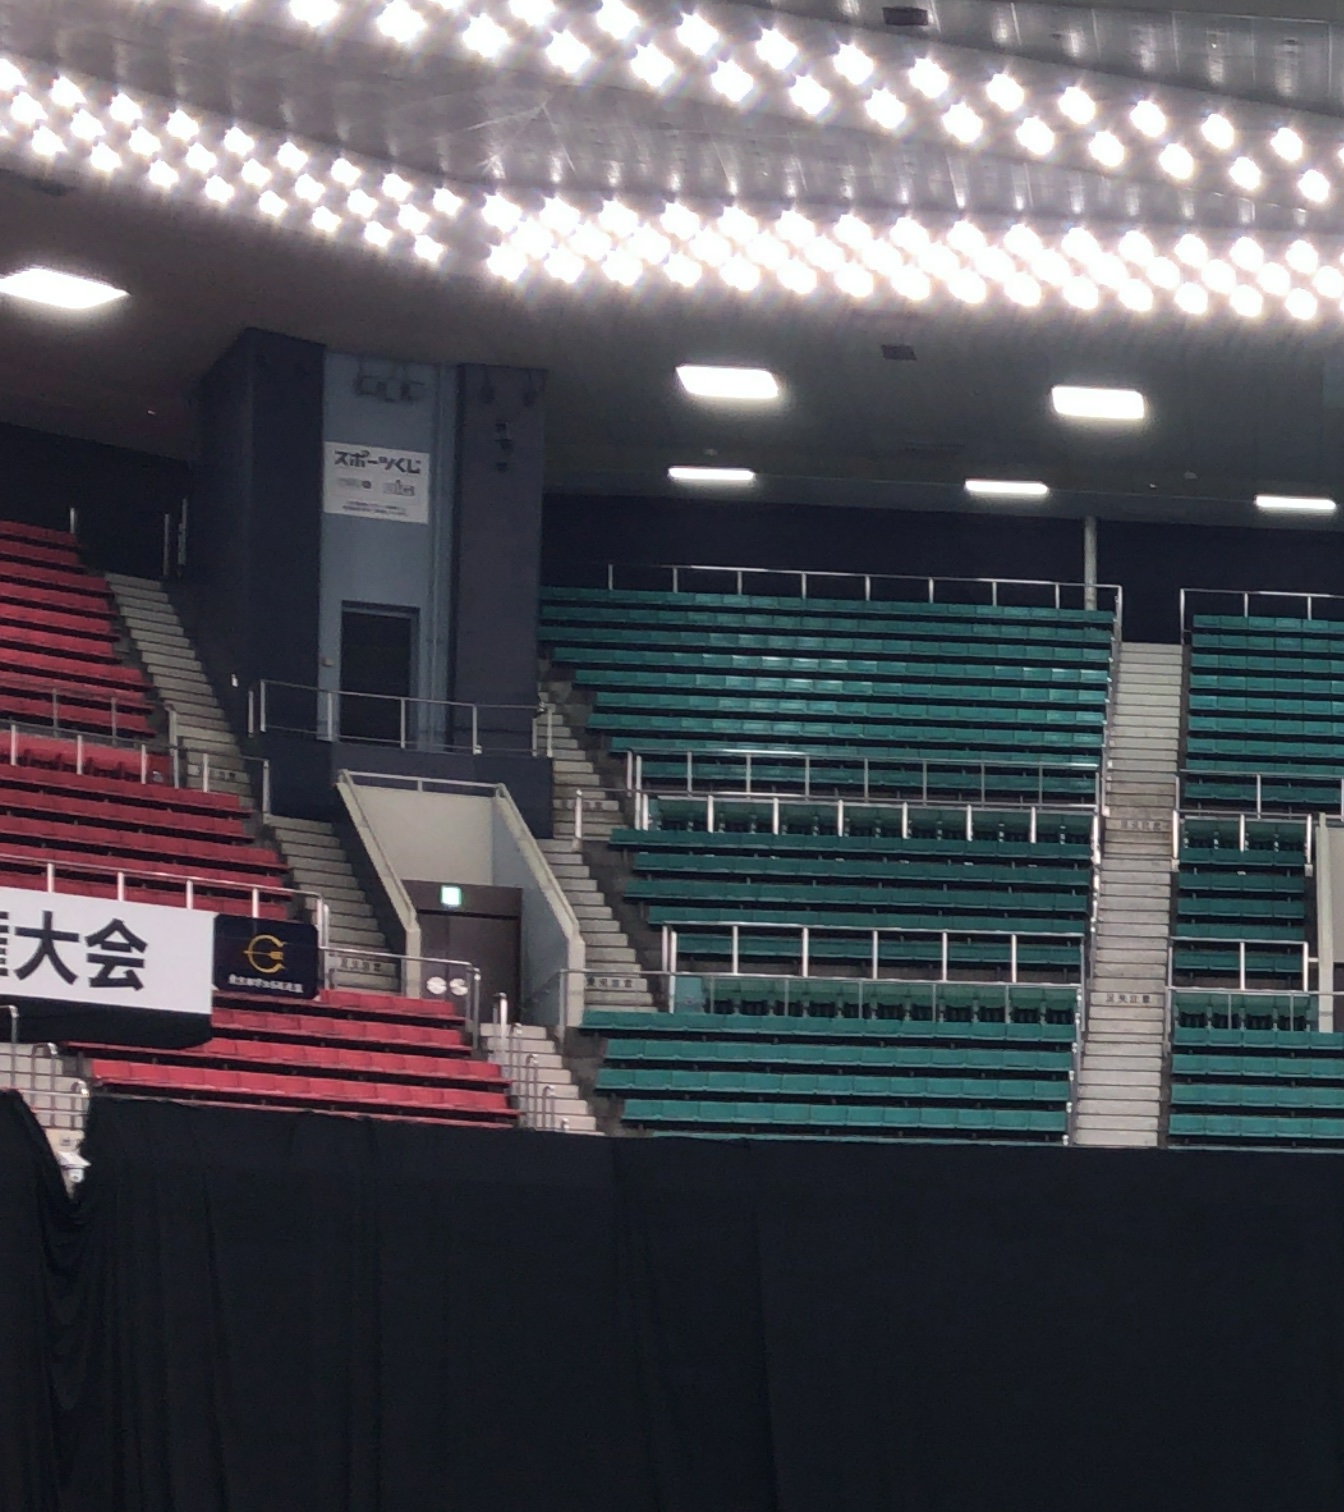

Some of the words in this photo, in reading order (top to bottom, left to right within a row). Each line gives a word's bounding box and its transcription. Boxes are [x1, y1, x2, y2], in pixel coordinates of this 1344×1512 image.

[334, 449, 422, 474] スポーツくじ
[0, 906, 149, 992] 大会
